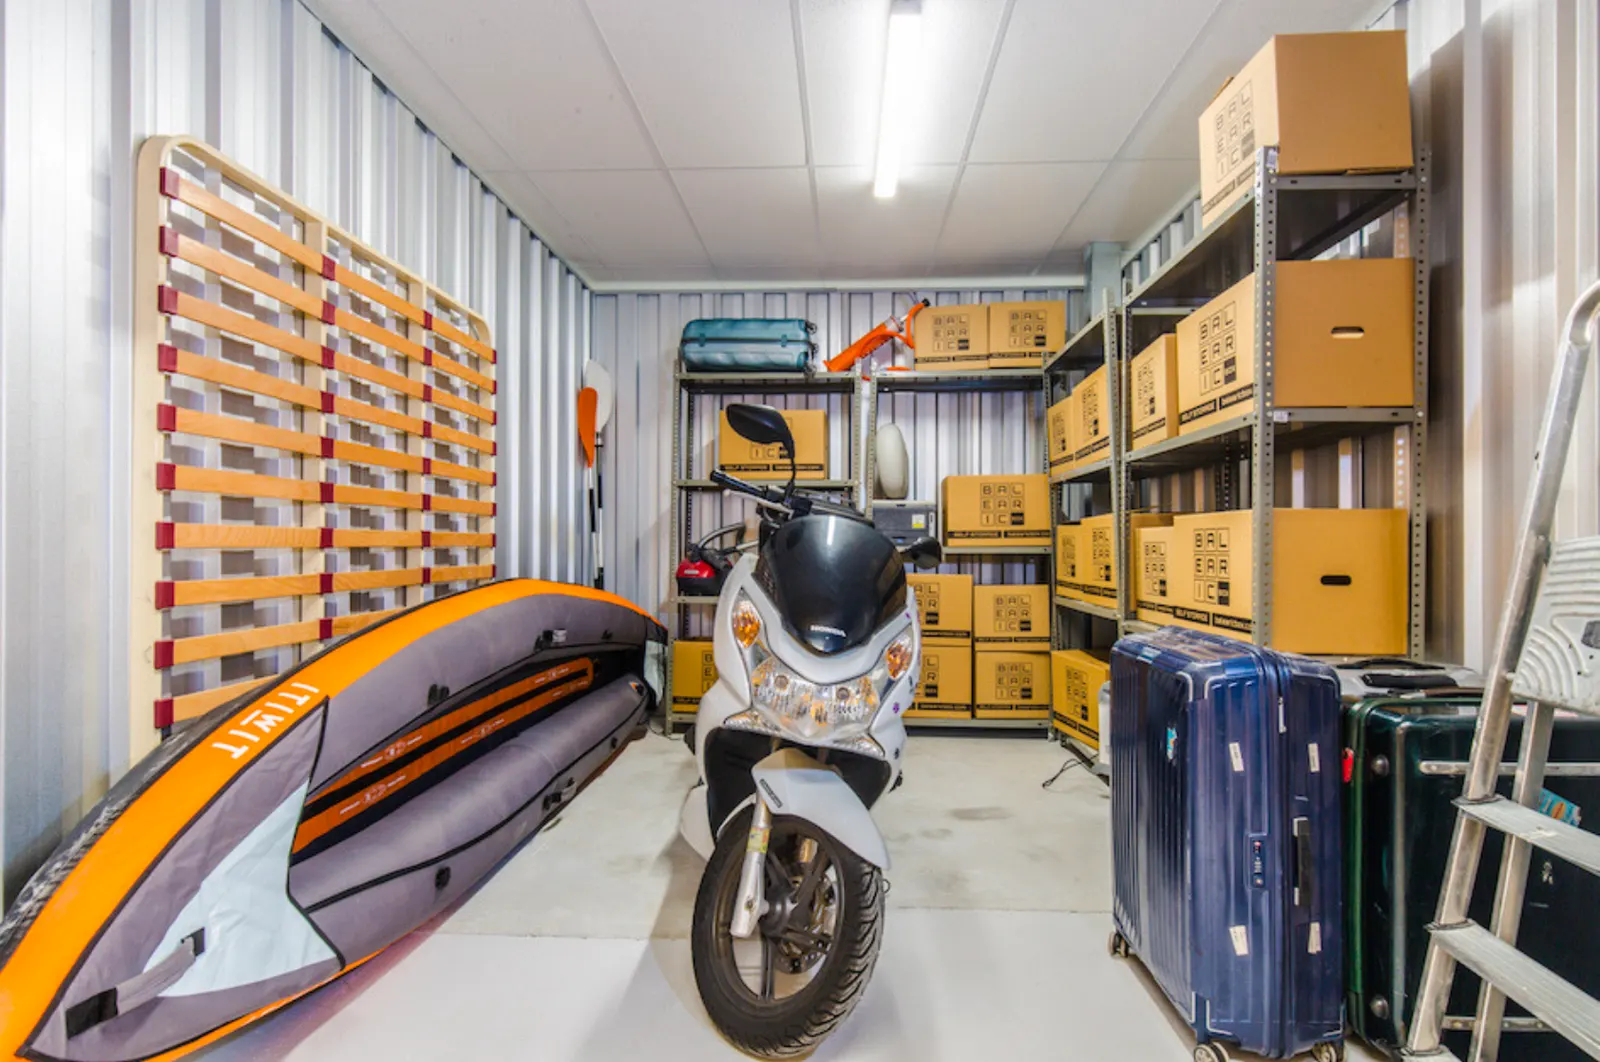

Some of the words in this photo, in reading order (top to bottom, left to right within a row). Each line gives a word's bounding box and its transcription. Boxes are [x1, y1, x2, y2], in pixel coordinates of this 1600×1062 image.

[1201, 309, 1233, 340] BAL
[1201, 335, 1234, 366] EAR
[983, 486, 1022, 495] BAL
[983, 500, 1023, 509] EAR
[1195, 533, 1227, 548] BAL
[1195, 558, 1227, 573] EAR
[211, 682, 320, 759] ITIWIT
